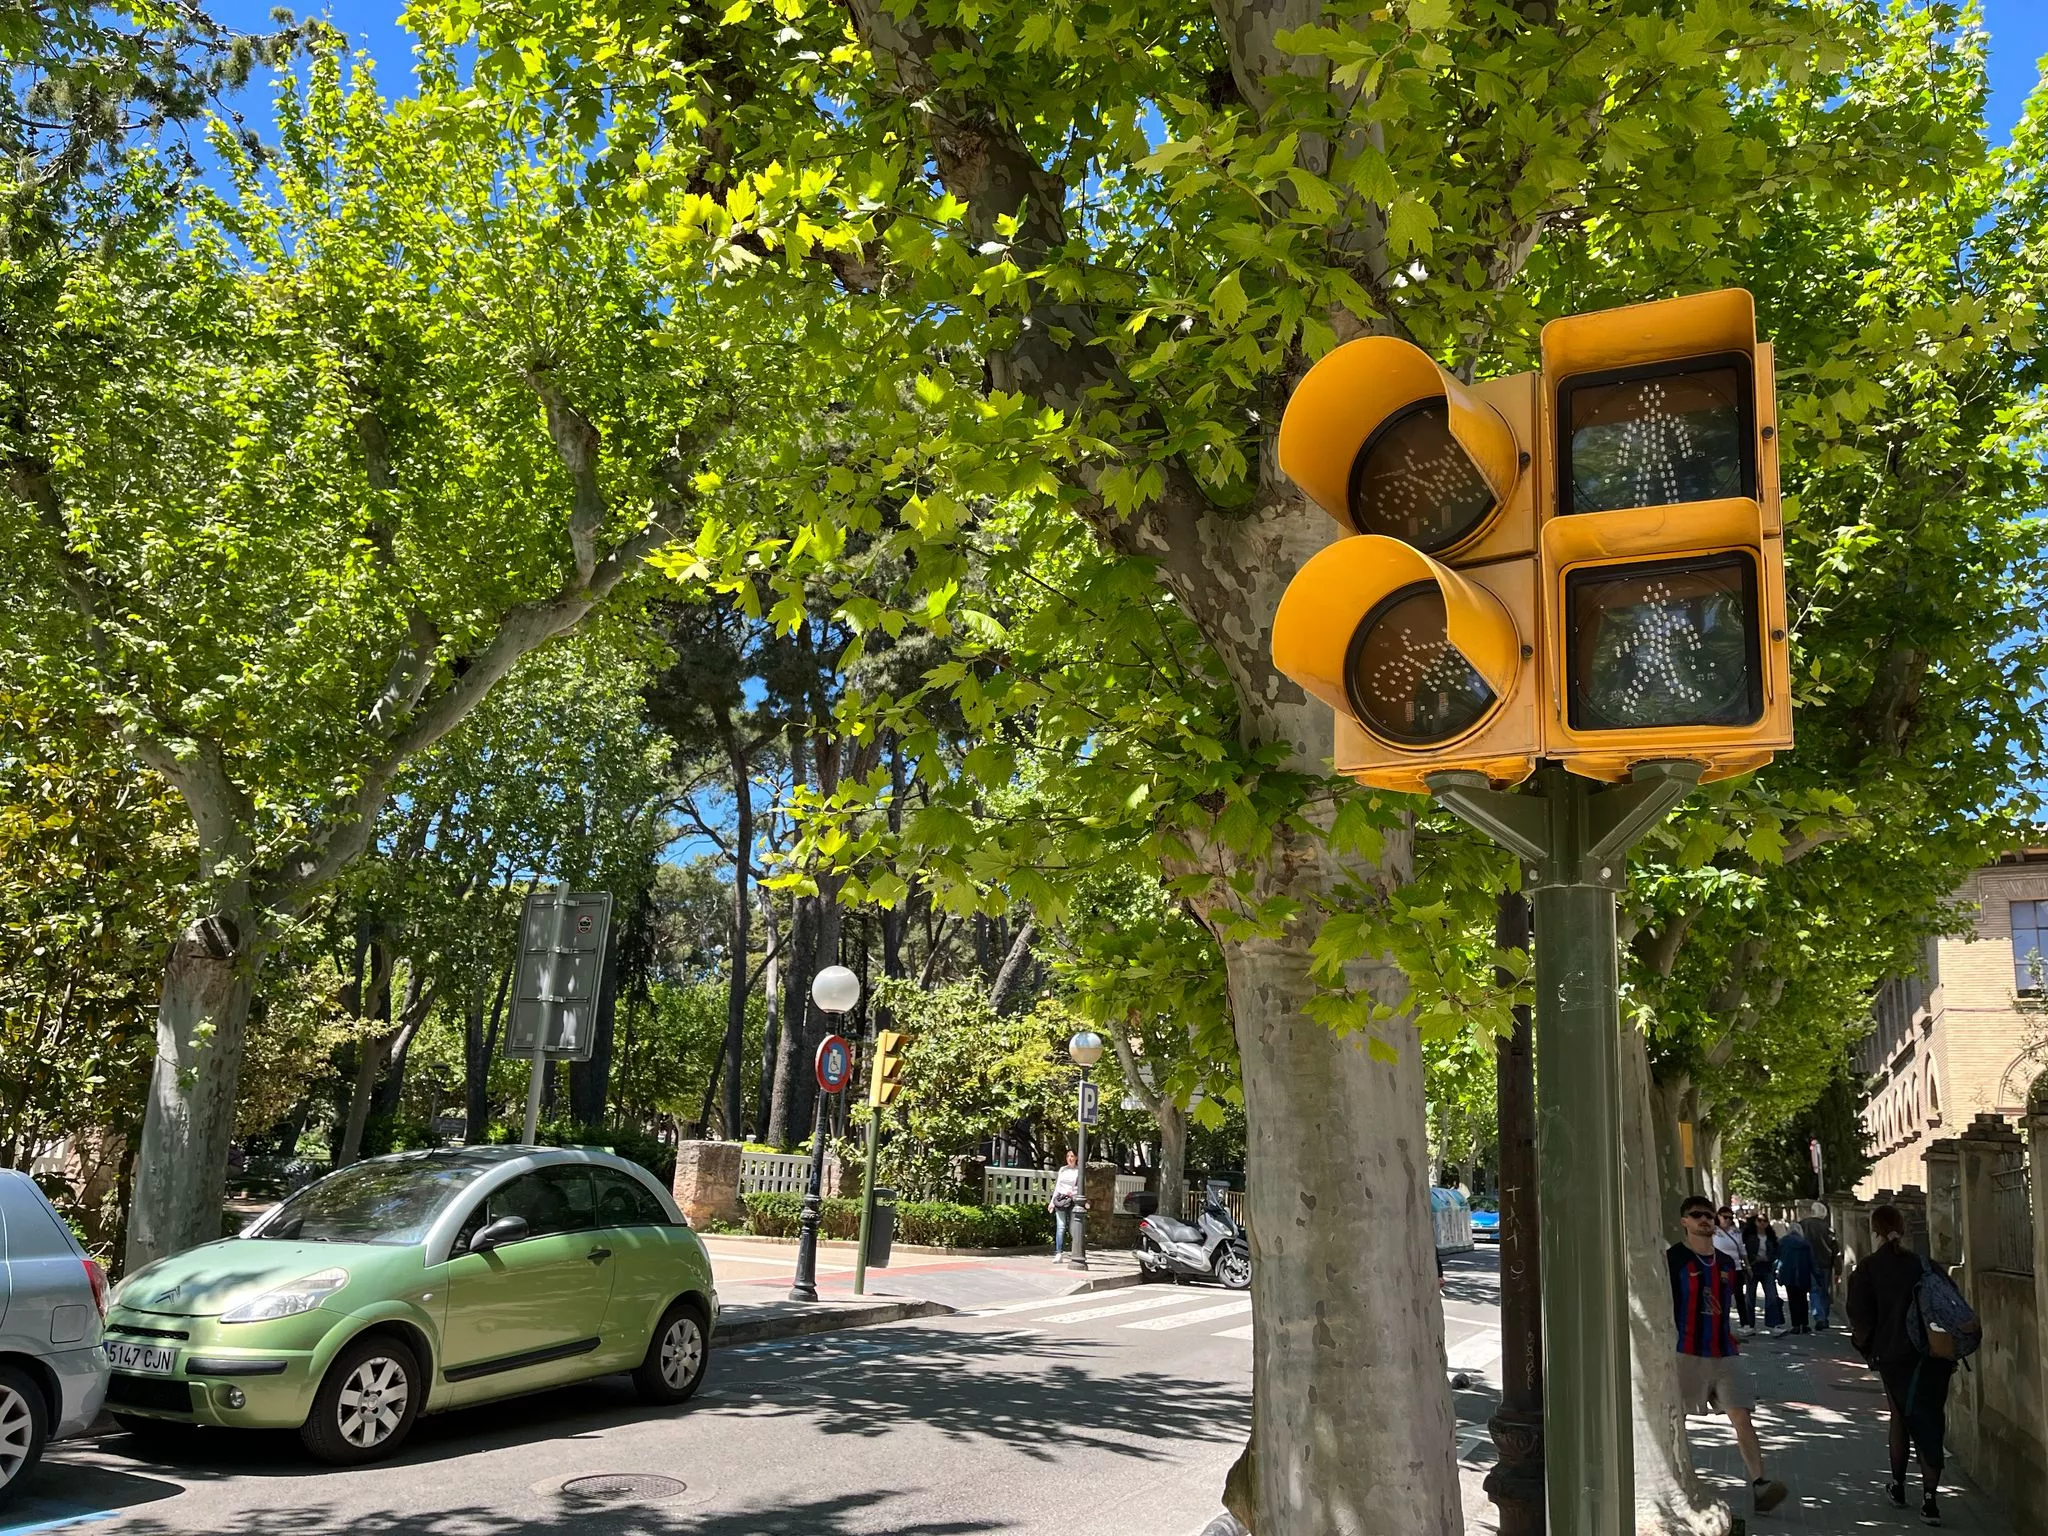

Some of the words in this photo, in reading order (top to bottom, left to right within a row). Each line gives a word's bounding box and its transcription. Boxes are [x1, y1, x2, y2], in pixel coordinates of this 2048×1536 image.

[1084, 1087, 1095, 1118] P
[109, 1345, 140, 1366] 5147
[144, 1349, 171, 1370] CJN
